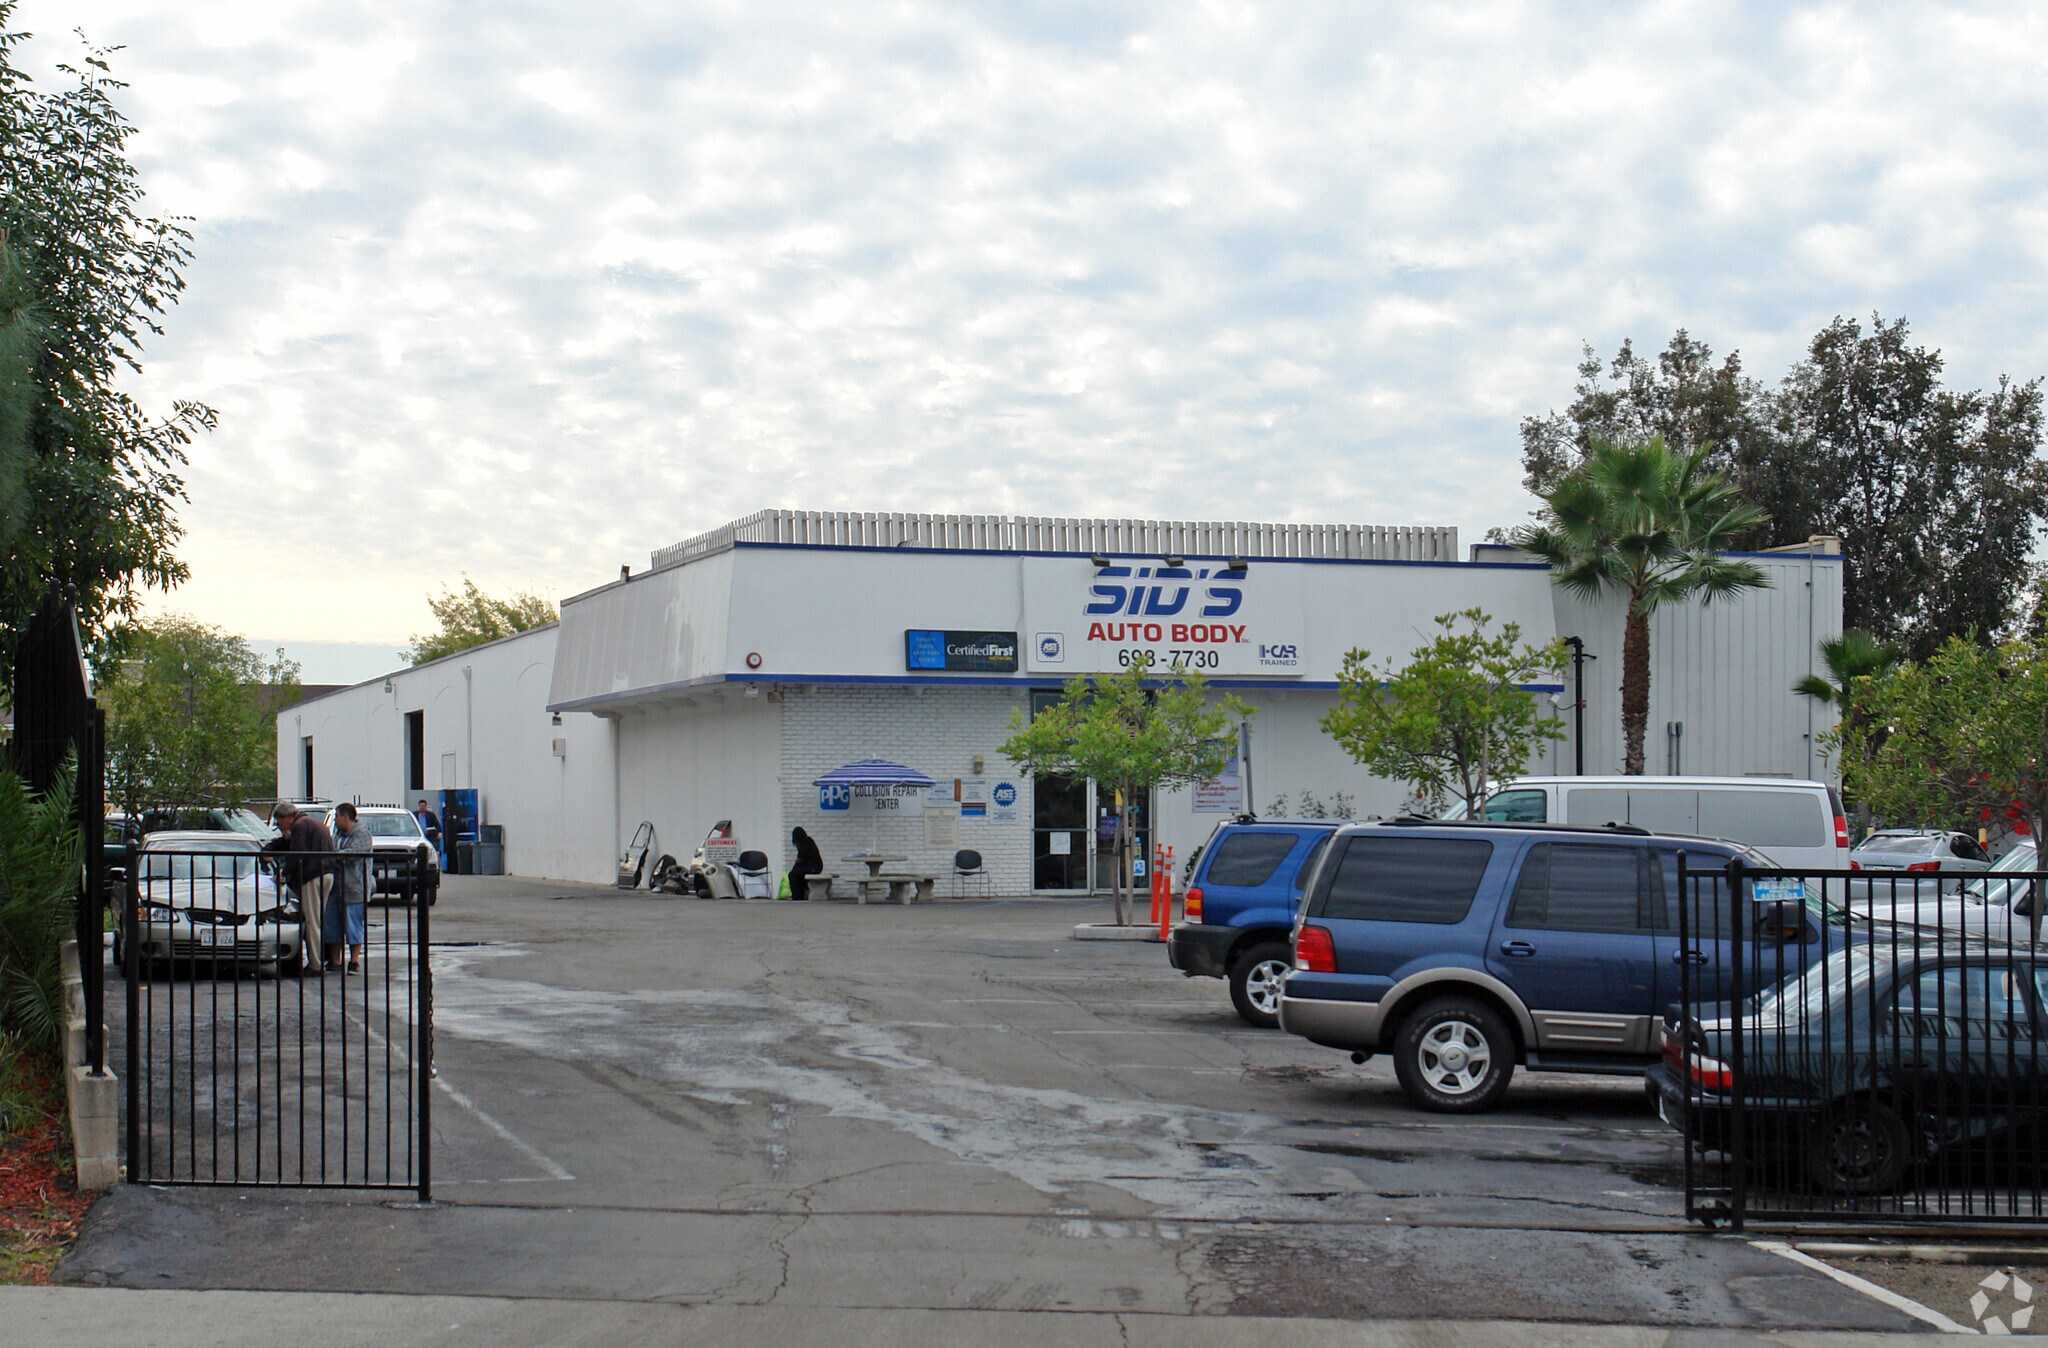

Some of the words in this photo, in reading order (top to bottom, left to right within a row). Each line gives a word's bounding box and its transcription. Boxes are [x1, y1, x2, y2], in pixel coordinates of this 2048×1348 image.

[1087, 622, 1162, 642] AUTO
[1171, 624, 1246, 643] BODY
[854, 785, 890, 797] COLLISION
[893, 785, 917, 796] REPAIR
[996, 789, 1014, 799] ASE
